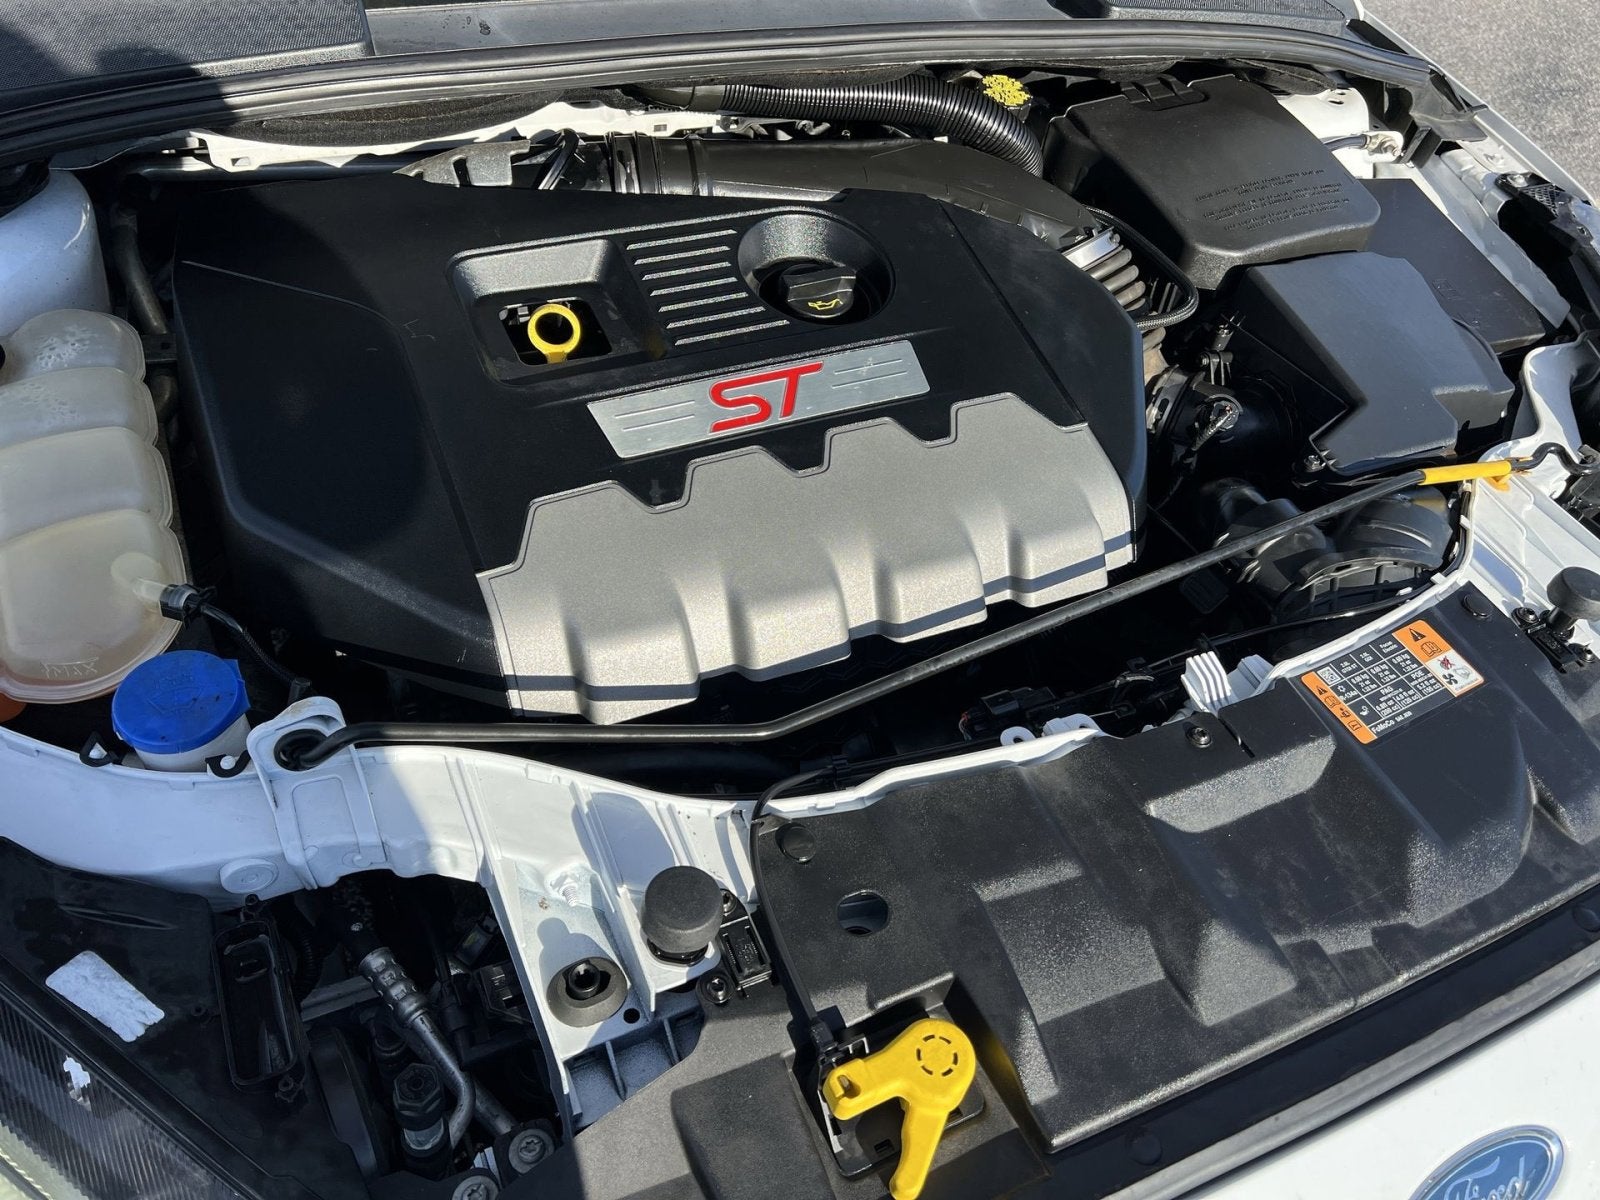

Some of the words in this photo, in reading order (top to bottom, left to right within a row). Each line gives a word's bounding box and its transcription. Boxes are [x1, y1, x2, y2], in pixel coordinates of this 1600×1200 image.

[708, 360, 824, 434] ST
[1380, 686, 1394, 695] PAG
[1371, 720, 1395, 733] FoMoCo
